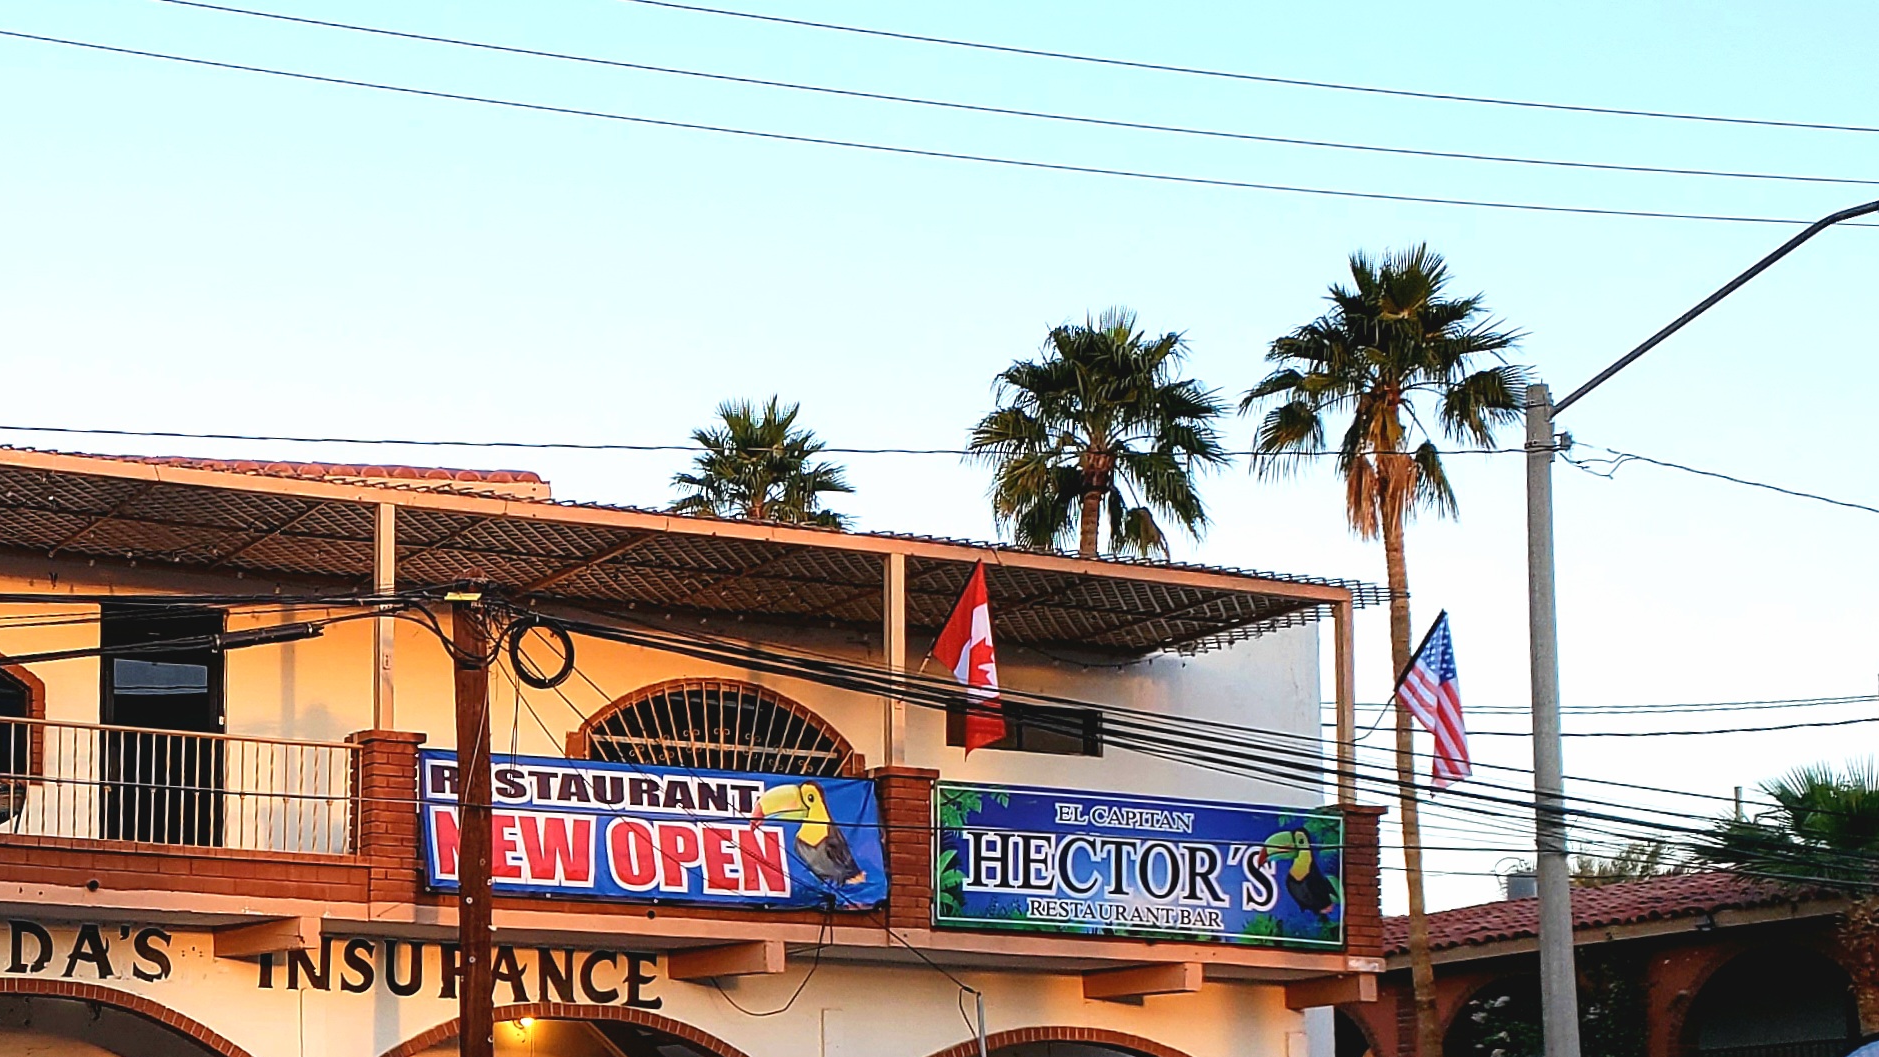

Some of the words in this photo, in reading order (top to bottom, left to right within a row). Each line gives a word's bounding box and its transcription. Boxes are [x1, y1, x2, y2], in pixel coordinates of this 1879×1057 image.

[430, 765, 761, 815] RSTAURANT
[1058, 806, 1089, 824] EL
[1091, 808, 1193, 832] CAPITAN
[612, 822, 789, 894] OPEN
[965, 831, 1276, 908] HECTOR'S
[1030, 901, 1176, 925] RESTAURANT
[1179, 910, 1223, 928] BAR
